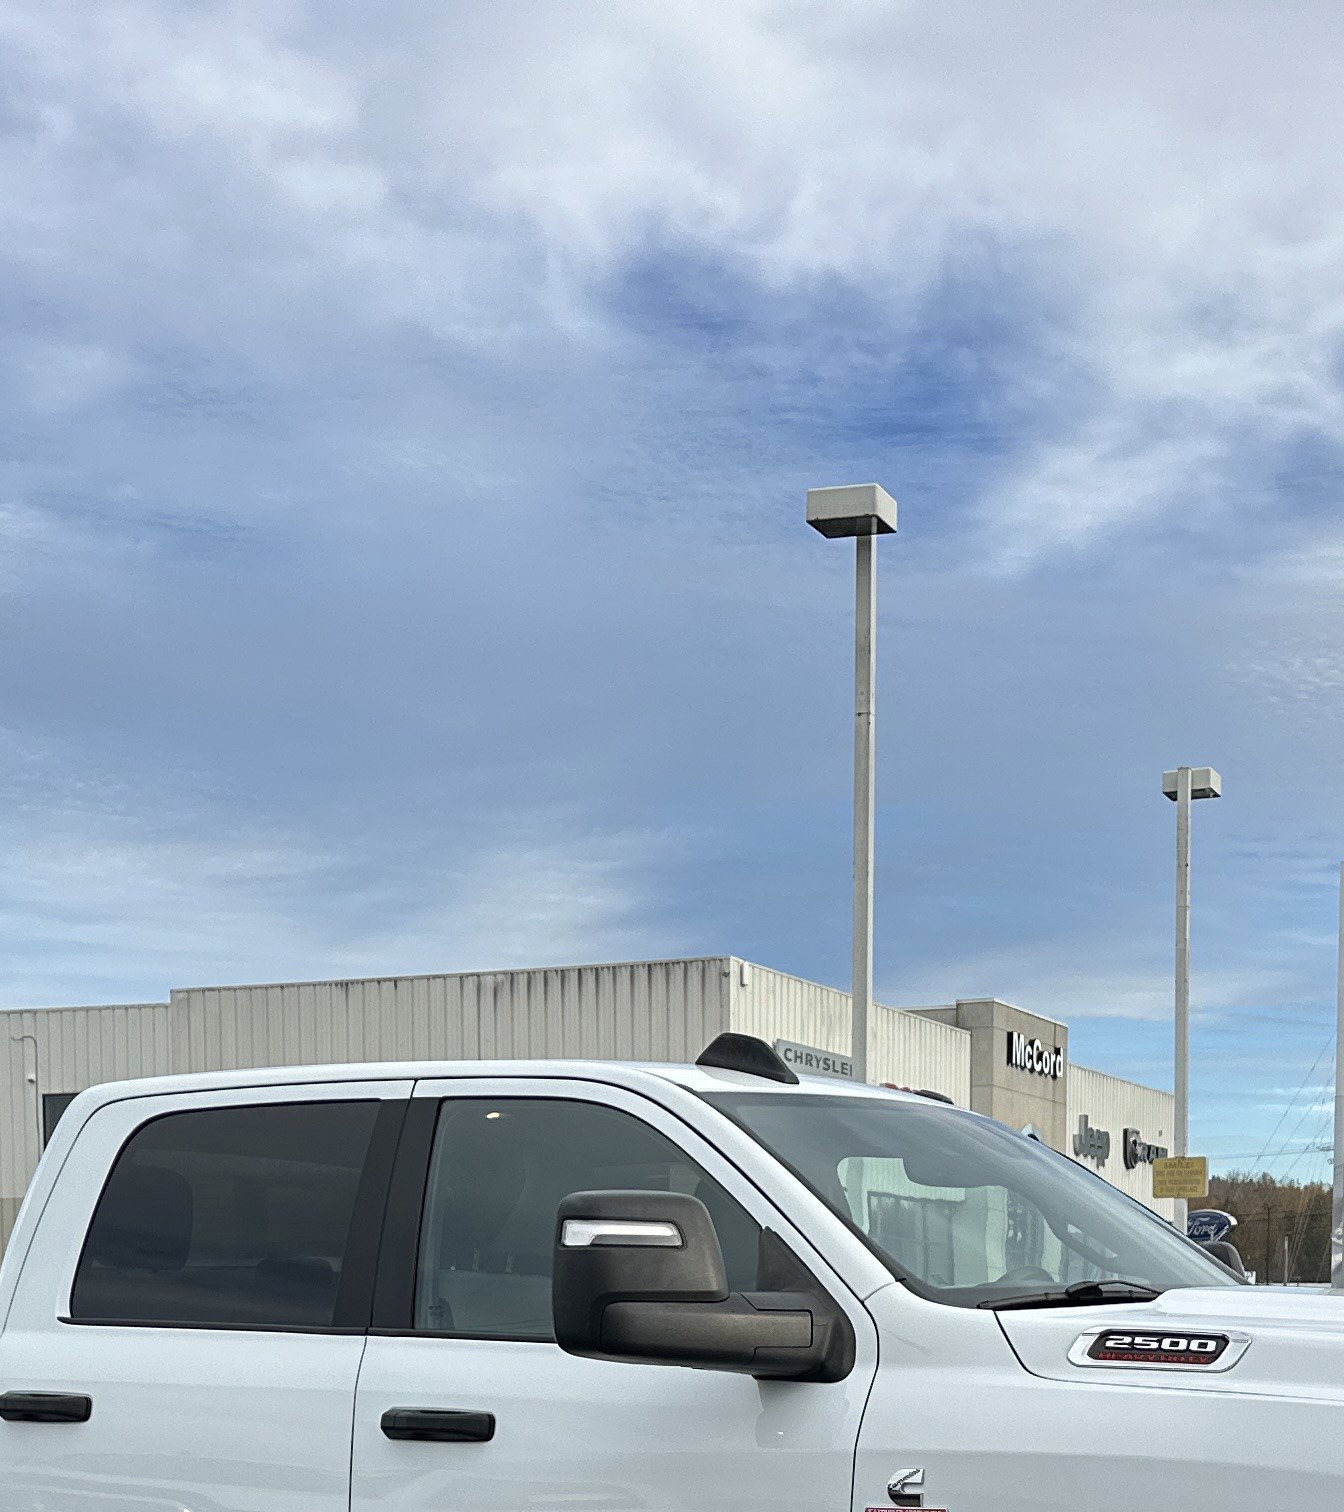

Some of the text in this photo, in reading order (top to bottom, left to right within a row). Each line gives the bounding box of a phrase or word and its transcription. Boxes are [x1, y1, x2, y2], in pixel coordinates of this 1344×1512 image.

[784, 1047, 853, 1077] CHRYSLE
[1008, 1031, 1063, 1078] McCord
[1073, 1114, 1110, 1169] Jeep
[1105, 1335, 1217, 1352] 2500
